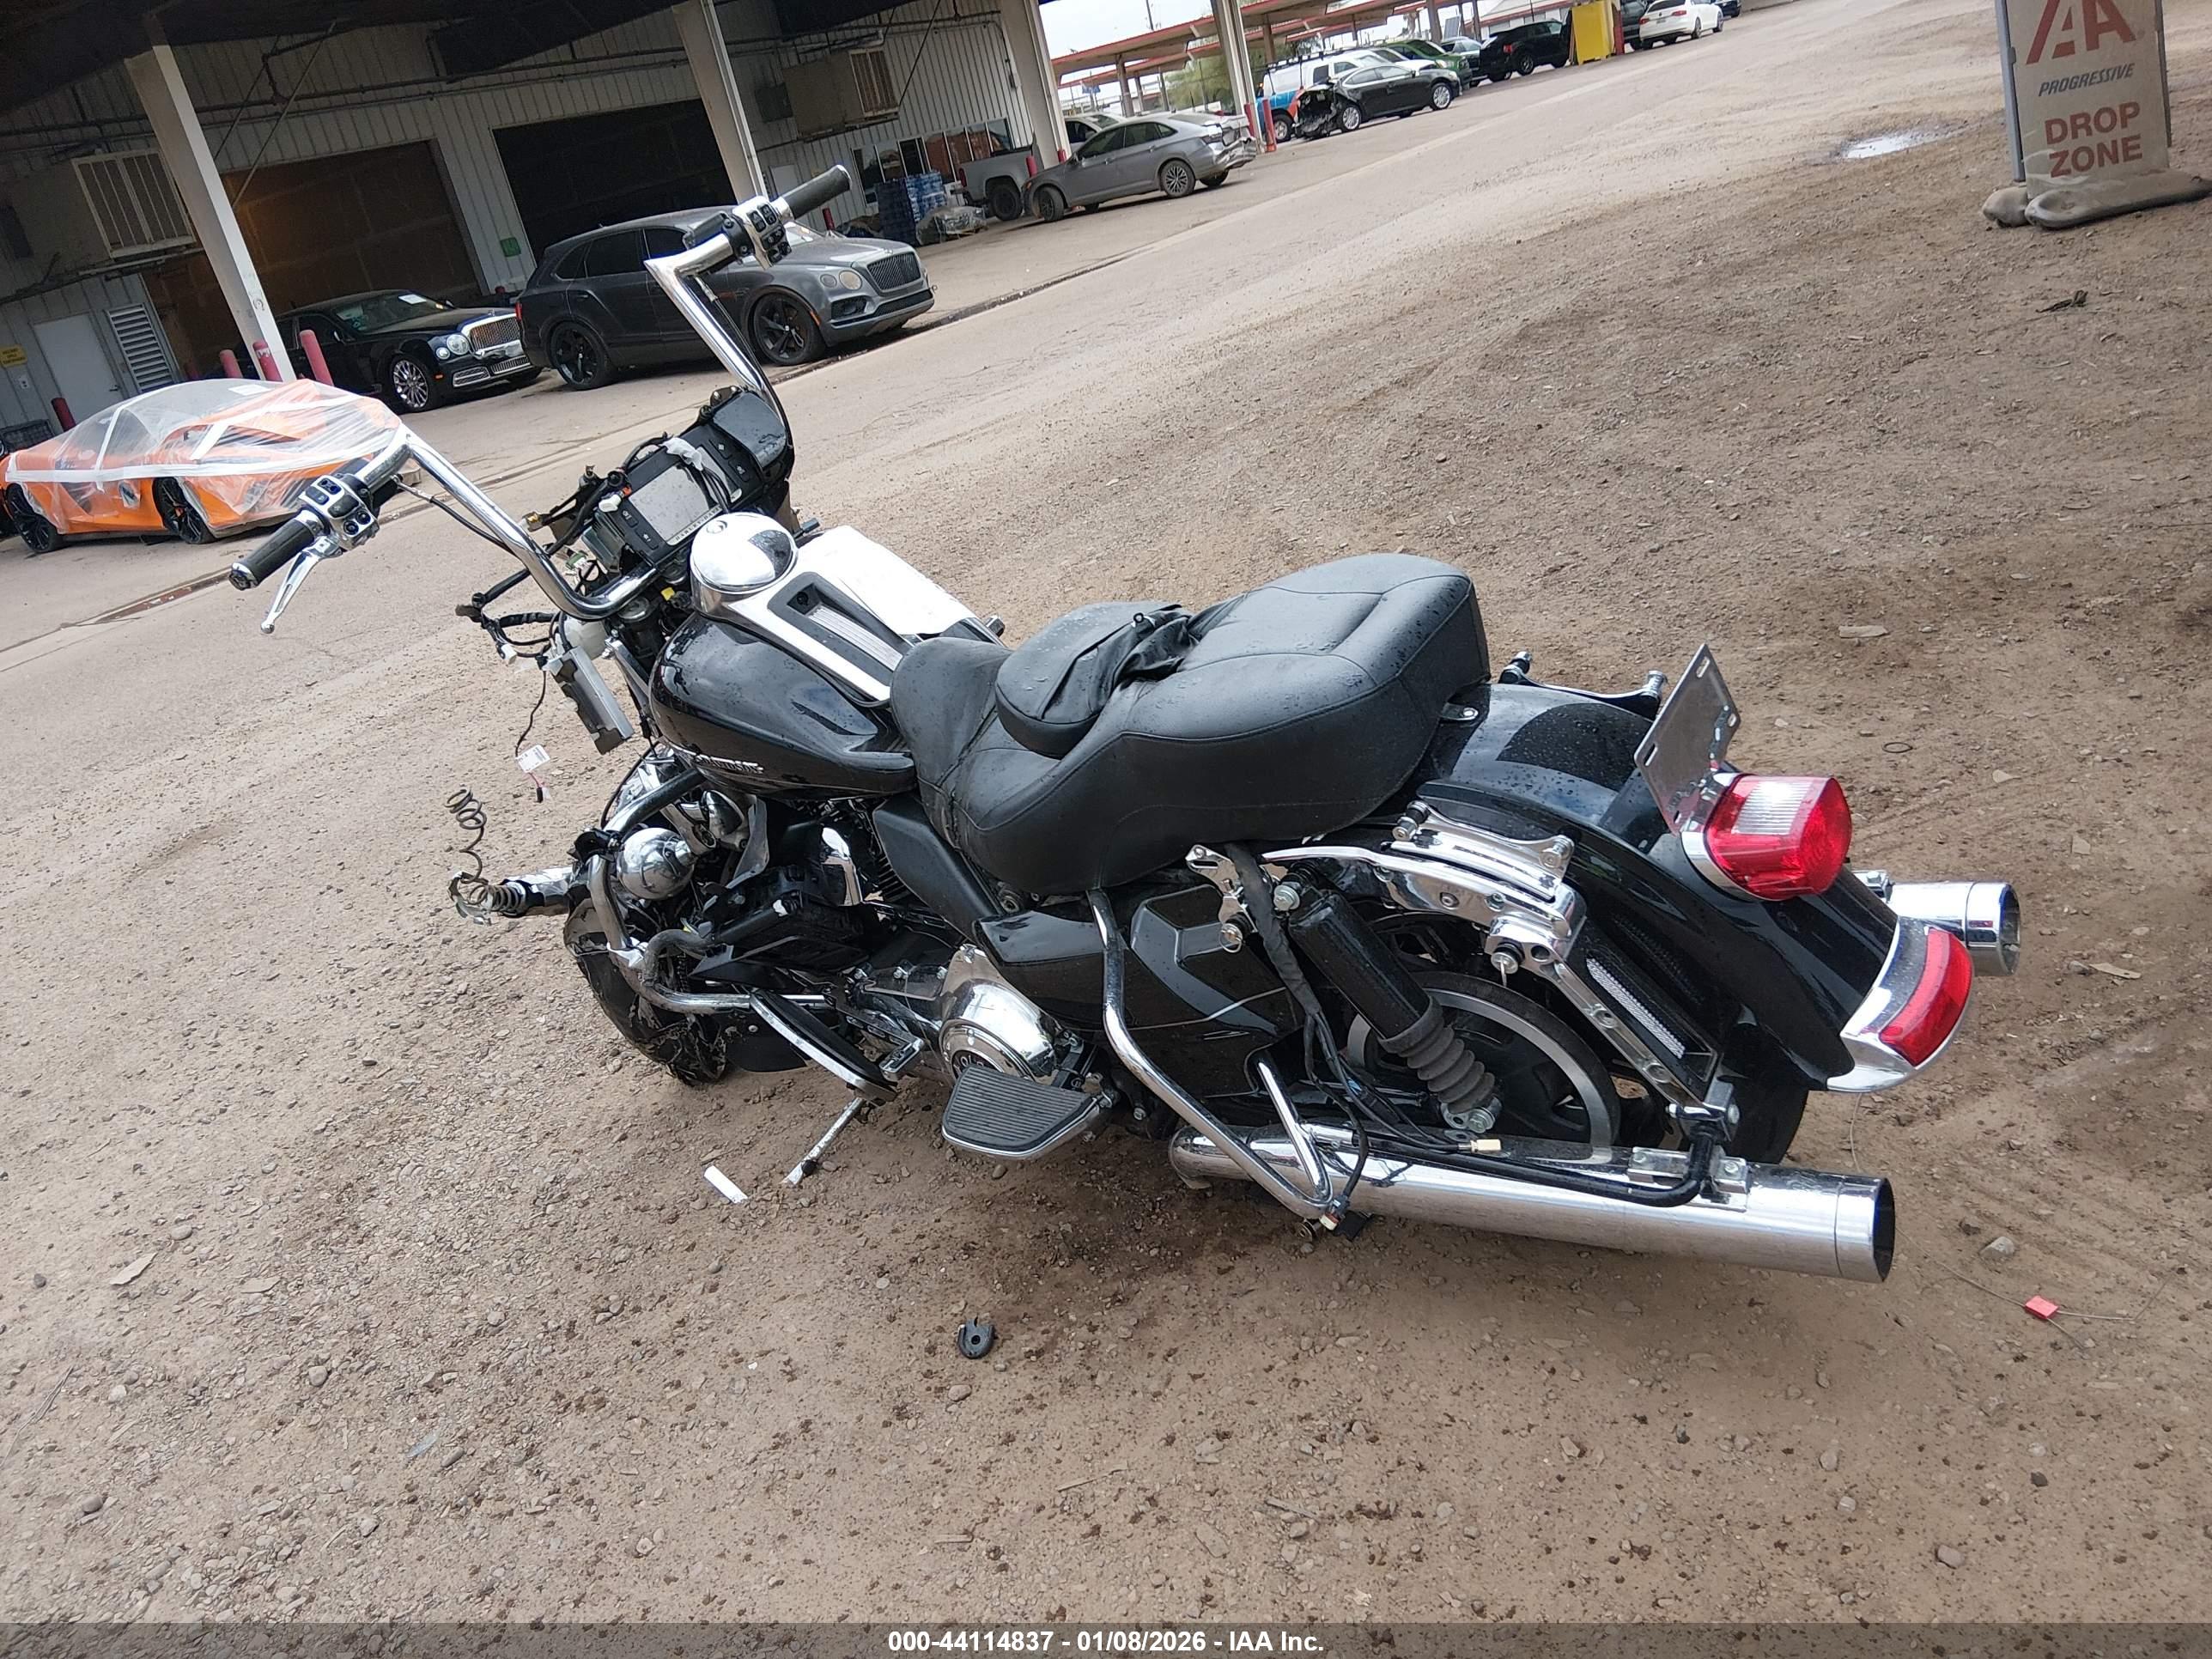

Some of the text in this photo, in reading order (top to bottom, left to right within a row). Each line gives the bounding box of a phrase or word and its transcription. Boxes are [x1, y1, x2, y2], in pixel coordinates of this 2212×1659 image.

[2038, 63, 2135, 96] PROGRESSIVE
[2045, 101, 2141, 145] DROP
[2049, 134, 2142, 178] ZONE
